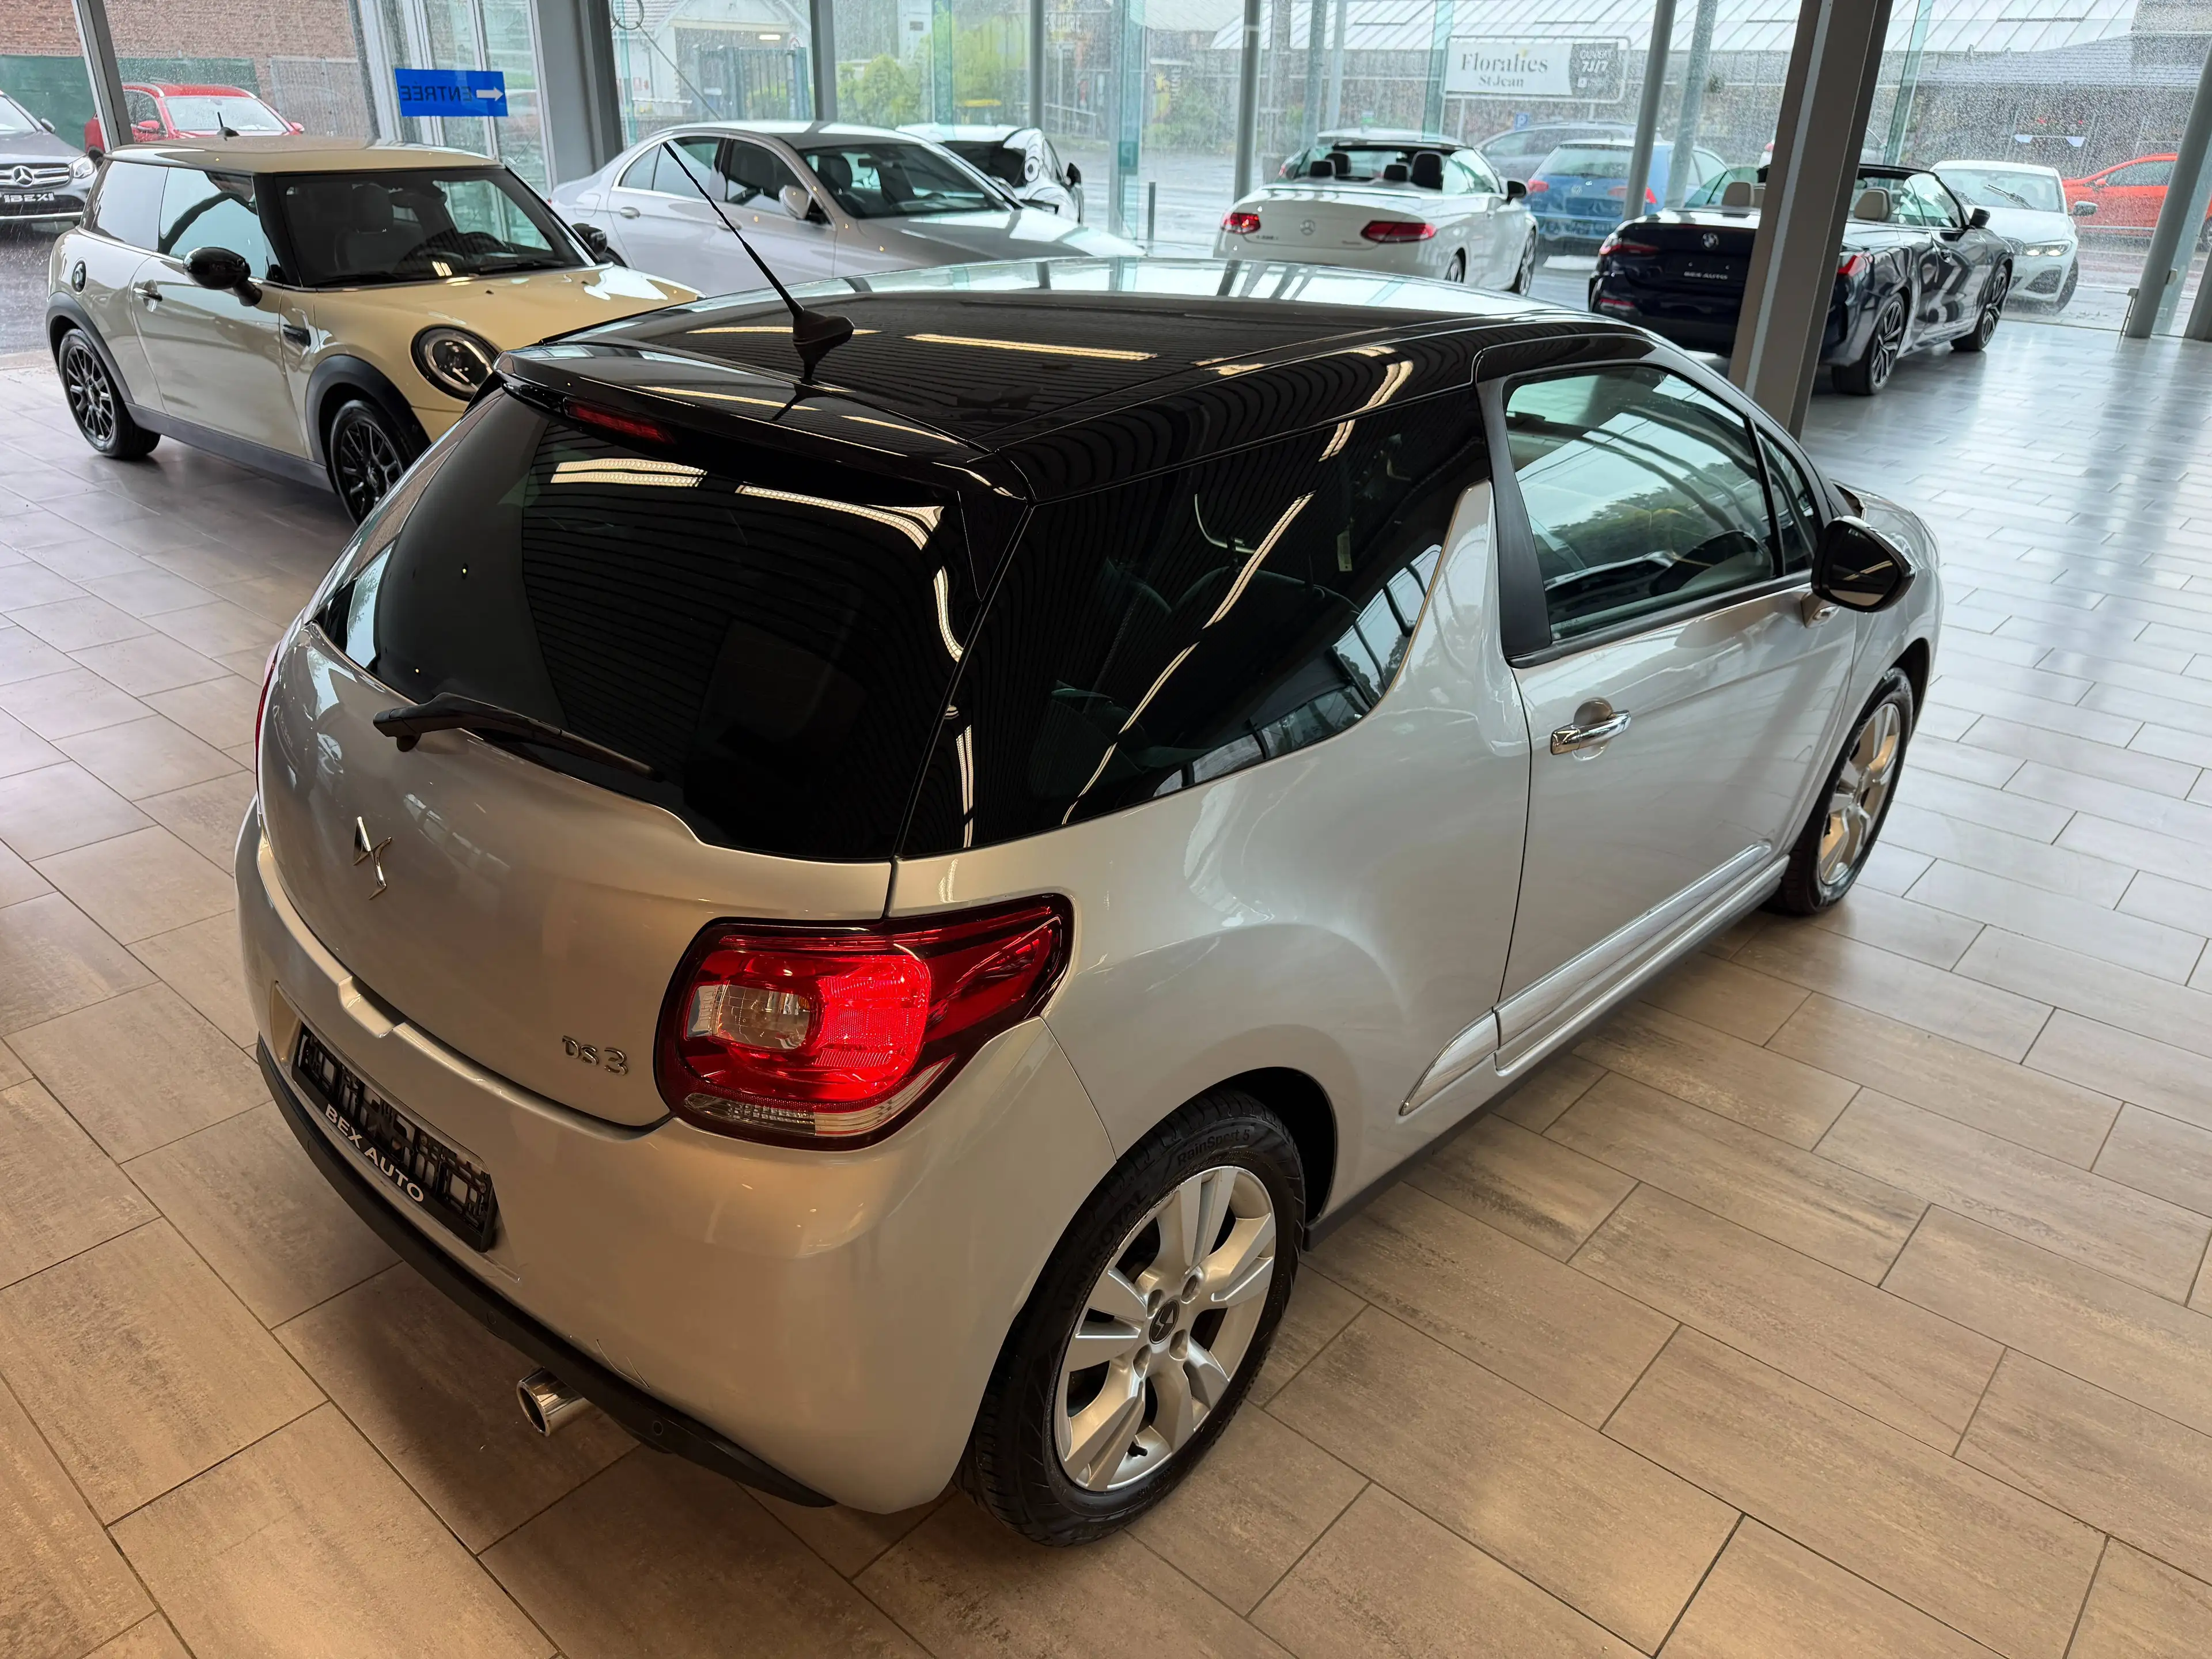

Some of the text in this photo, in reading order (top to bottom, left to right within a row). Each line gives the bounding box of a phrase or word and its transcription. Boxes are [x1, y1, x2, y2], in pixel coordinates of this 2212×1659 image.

[1461, 52, 1548, 73] Floralies
[325, 1104, 424, 1202] BEX AUTO
[1177, 1130, 1240, 1166] RainSport
[1243, 1129, 1250, 1141] 5
[1058, 1192, 1148, 1309] UNIROYAL
